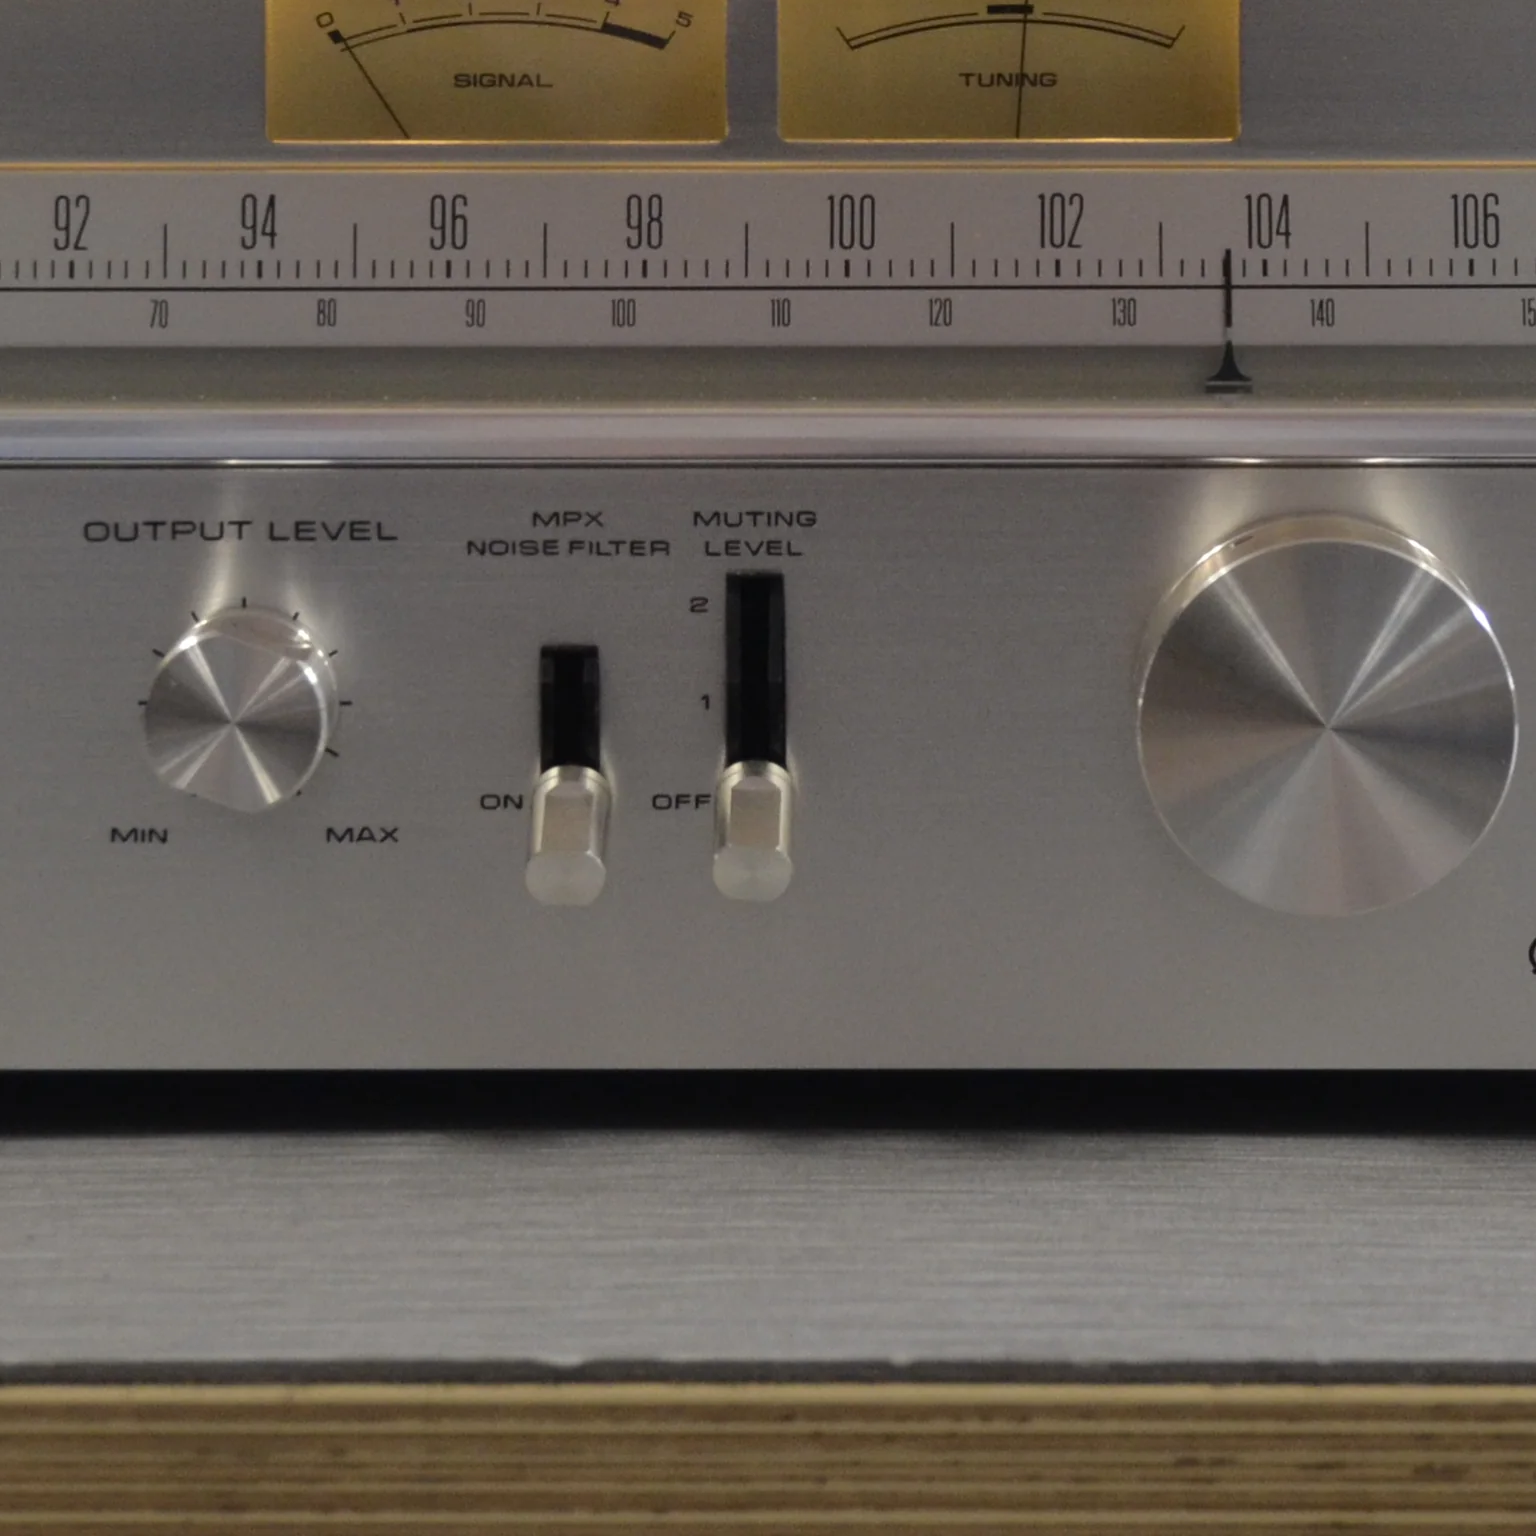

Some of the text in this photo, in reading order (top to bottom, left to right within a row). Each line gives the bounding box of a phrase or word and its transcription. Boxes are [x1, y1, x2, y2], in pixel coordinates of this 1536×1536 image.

[315, 11, 336, 29] 0
[674, 10, 695, 29] 5
[453, 72, 554, 89] SIGNAL
[958, 72, 1058, 89] TUNING
[53, 194, 91, 252] 92
[240, 193, 278, 251] 94
[429, 193, 468, 251] 96
[625, 193, 664, 250] 98
[827, 193, 876, 251] 100
[1037, 192, 1085, 249] 102
[1244, 192, 1292, 250] 104
[1450, 192, 1500, 250] 106
[149, 298, 169, 330] 70
[316, 297, 337, 328] 80
[465, 298, 486, 328] 90
[611, 297, 637, 329] 100
[770, 297, 792, 328] 110
[928, 297, 953, 327] 120
[1111, 297, 1137, 328] 130
[1310, 297, 1335, 328] 140
[532, 510, 604, 528] MPX
[693, 510, 817, 529] MUTING
[82, 520, 399, 543] OUTPUT LEVEL
[466, 538, 671, 557] NOISE FILTER
[704, 539, 803, 557] LEVEL
[689, 596, 709, 614] 2
[700, 693, 711, 711] 1
[479, 793, 524, 811] ON
[651, 793, 711, 810] OFF
[110, 827, 169, 845] MIN
[325, 826, 399, 844] MAX
